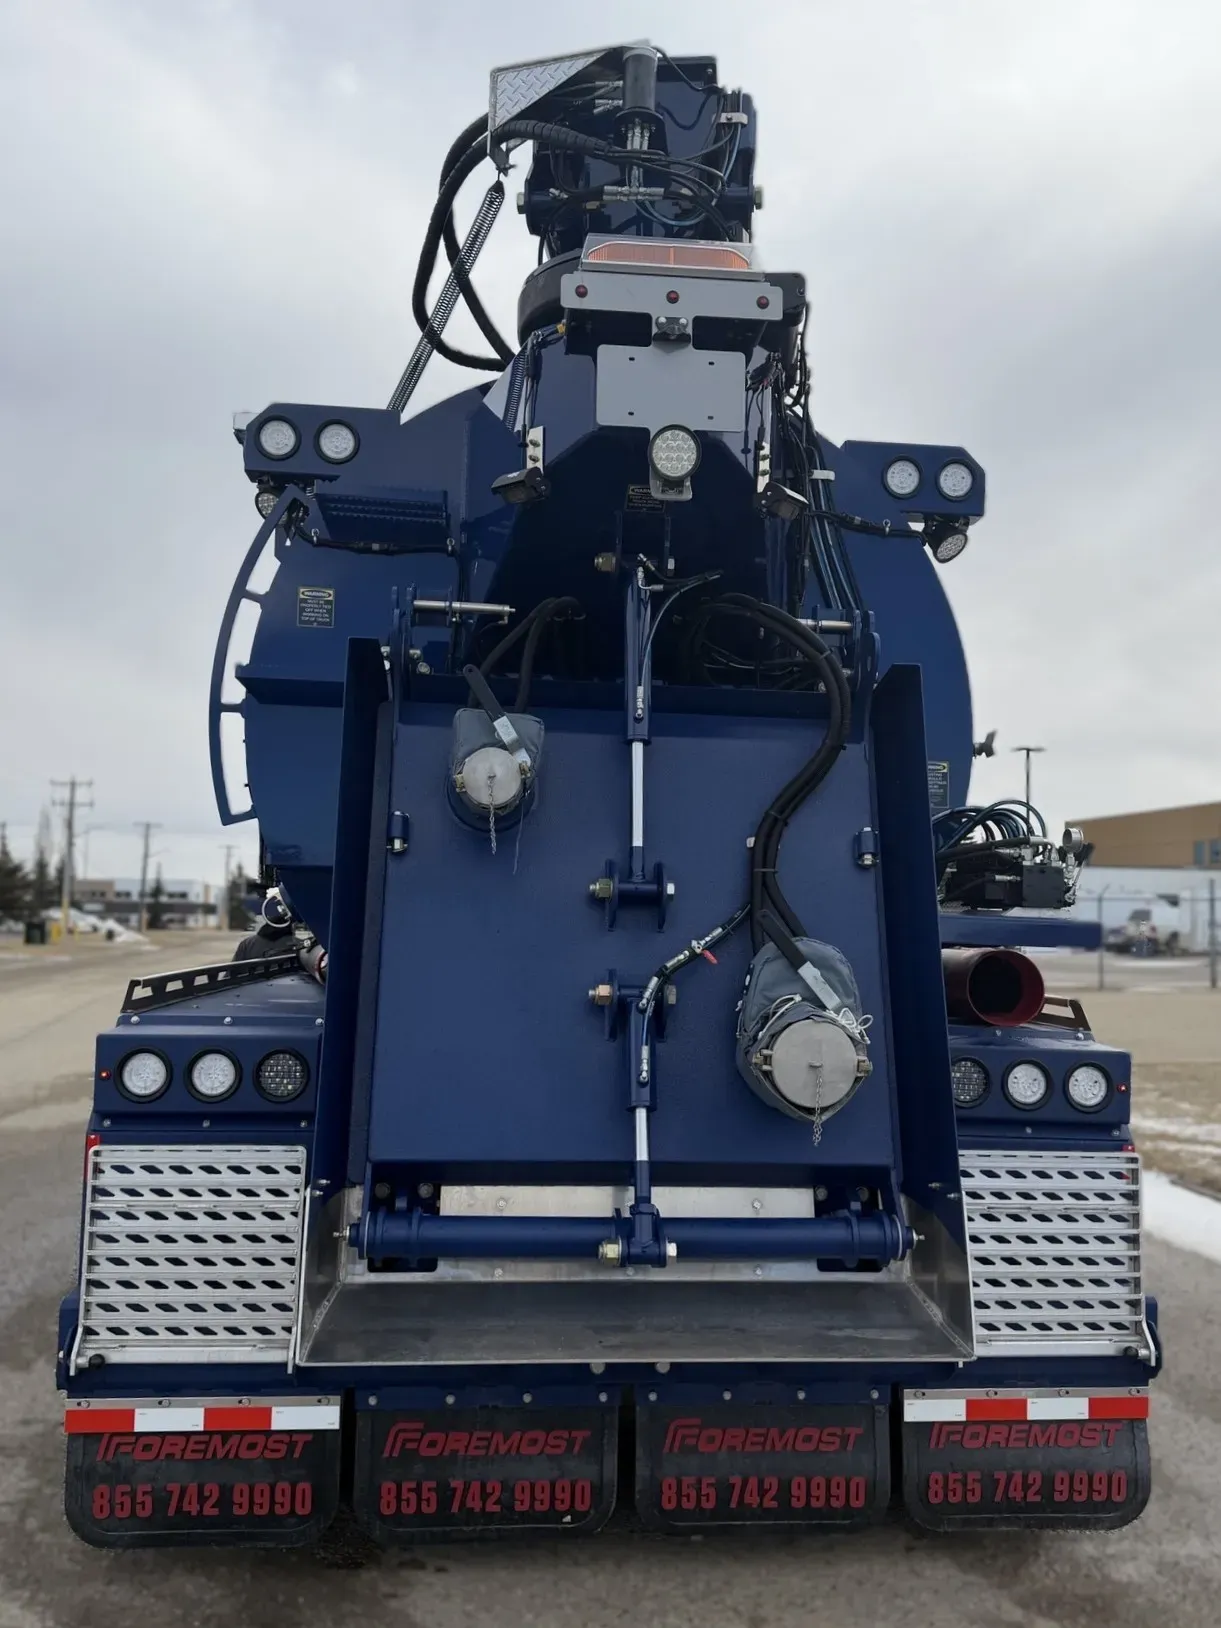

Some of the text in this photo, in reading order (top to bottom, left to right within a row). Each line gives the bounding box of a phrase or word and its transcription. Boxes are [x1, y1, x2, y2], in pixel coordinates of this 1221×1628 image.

[96, 1433, 313, 1462] FOREMOST
[382, 1421, 591, 1459] FOREMOST
[664, 1418, 864, 1453] FOREMOST
[929, 1423, 1123, 1449] FOREMOST
[92, 1481, 312, 1519] 855 742 9990
[379, 1478, 592, 1515] 855 742 9990
[661, 1475, 866, 1510] 855 742 9990
[928, 1470, 1128, 1504] 855 742 9990
